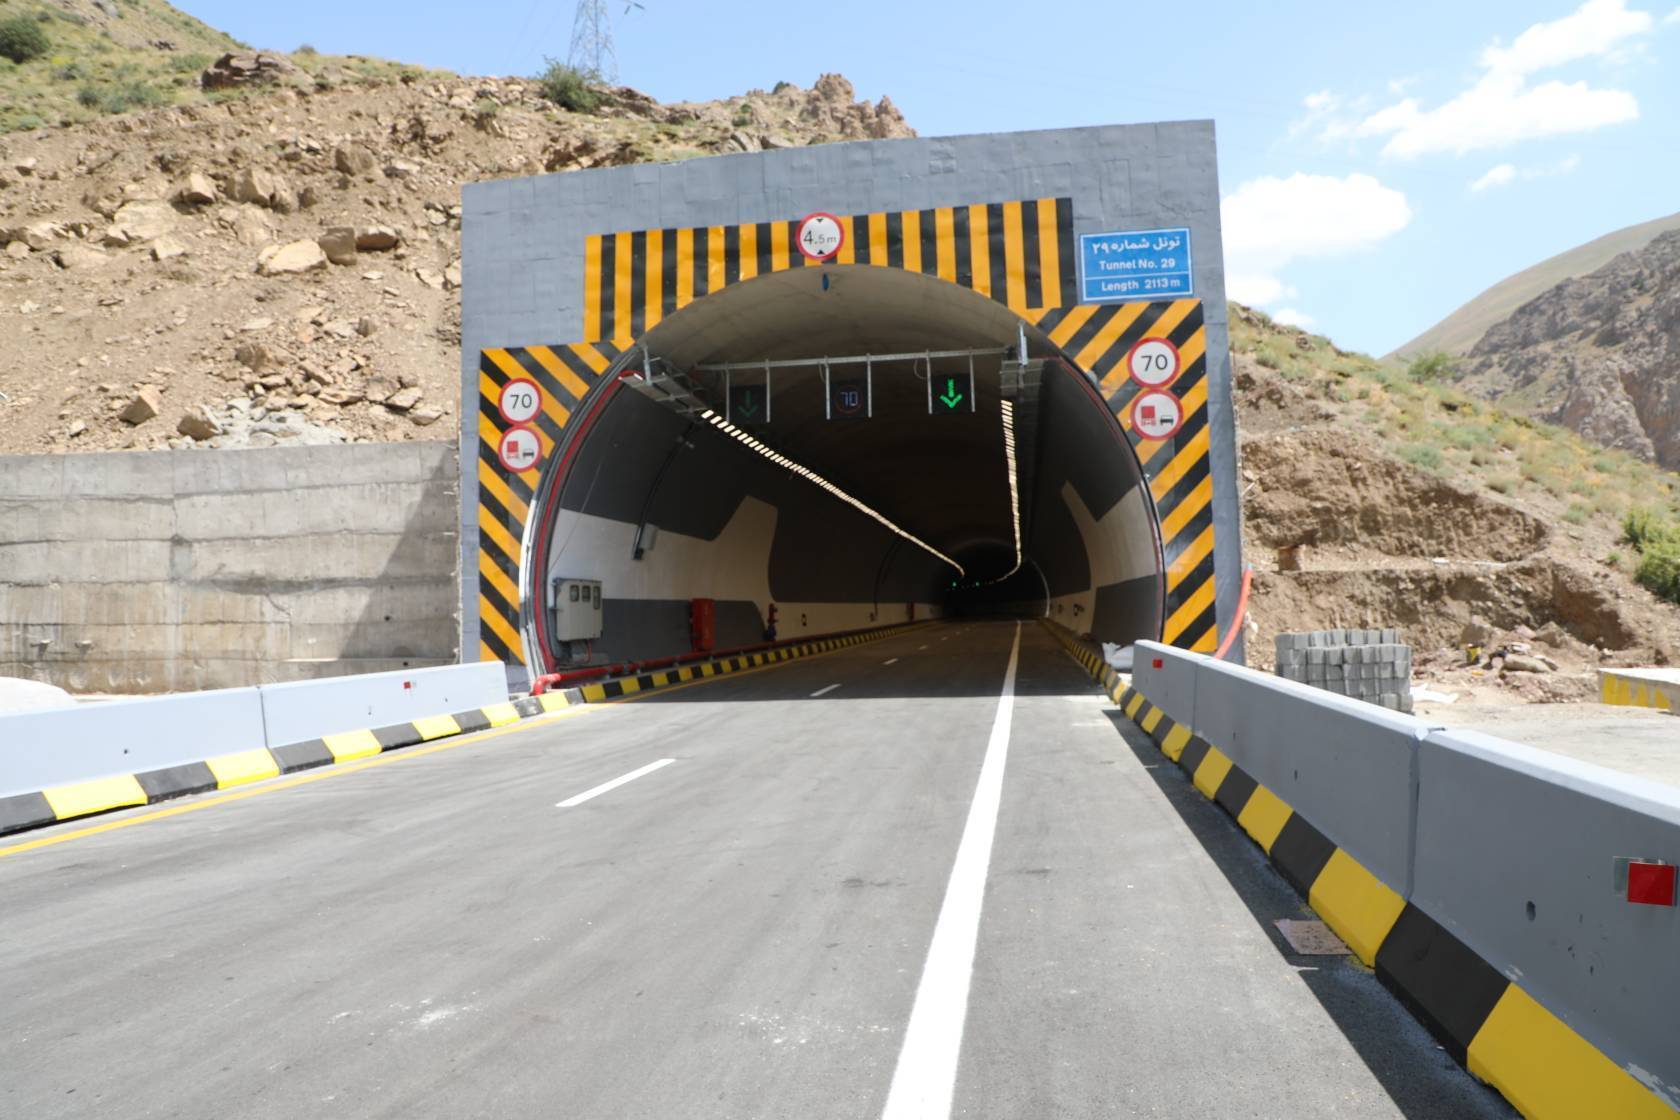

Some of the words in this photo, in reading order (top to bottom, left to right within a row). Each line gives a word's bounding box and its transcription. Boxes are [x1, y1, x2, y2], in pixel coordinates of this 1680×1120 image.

[1092, 242, 1109, 254] ۲۹
[1111, 238, 1150, 252] شماره
[1153, 236, 1180, 251] تونل
[1099, 259, 1136, 270] Tunnel
[1138, 259, 1158, 269] No.
[1161, 258, 1176, 268] 29
[1101, 280, 1139, 292] Length
[1144, 279, 1169, 289] 2113
[1141, 354, 1168, 371] 70
[510, 394, 533, 409] 70
[840, 391, 858, 407] 70
